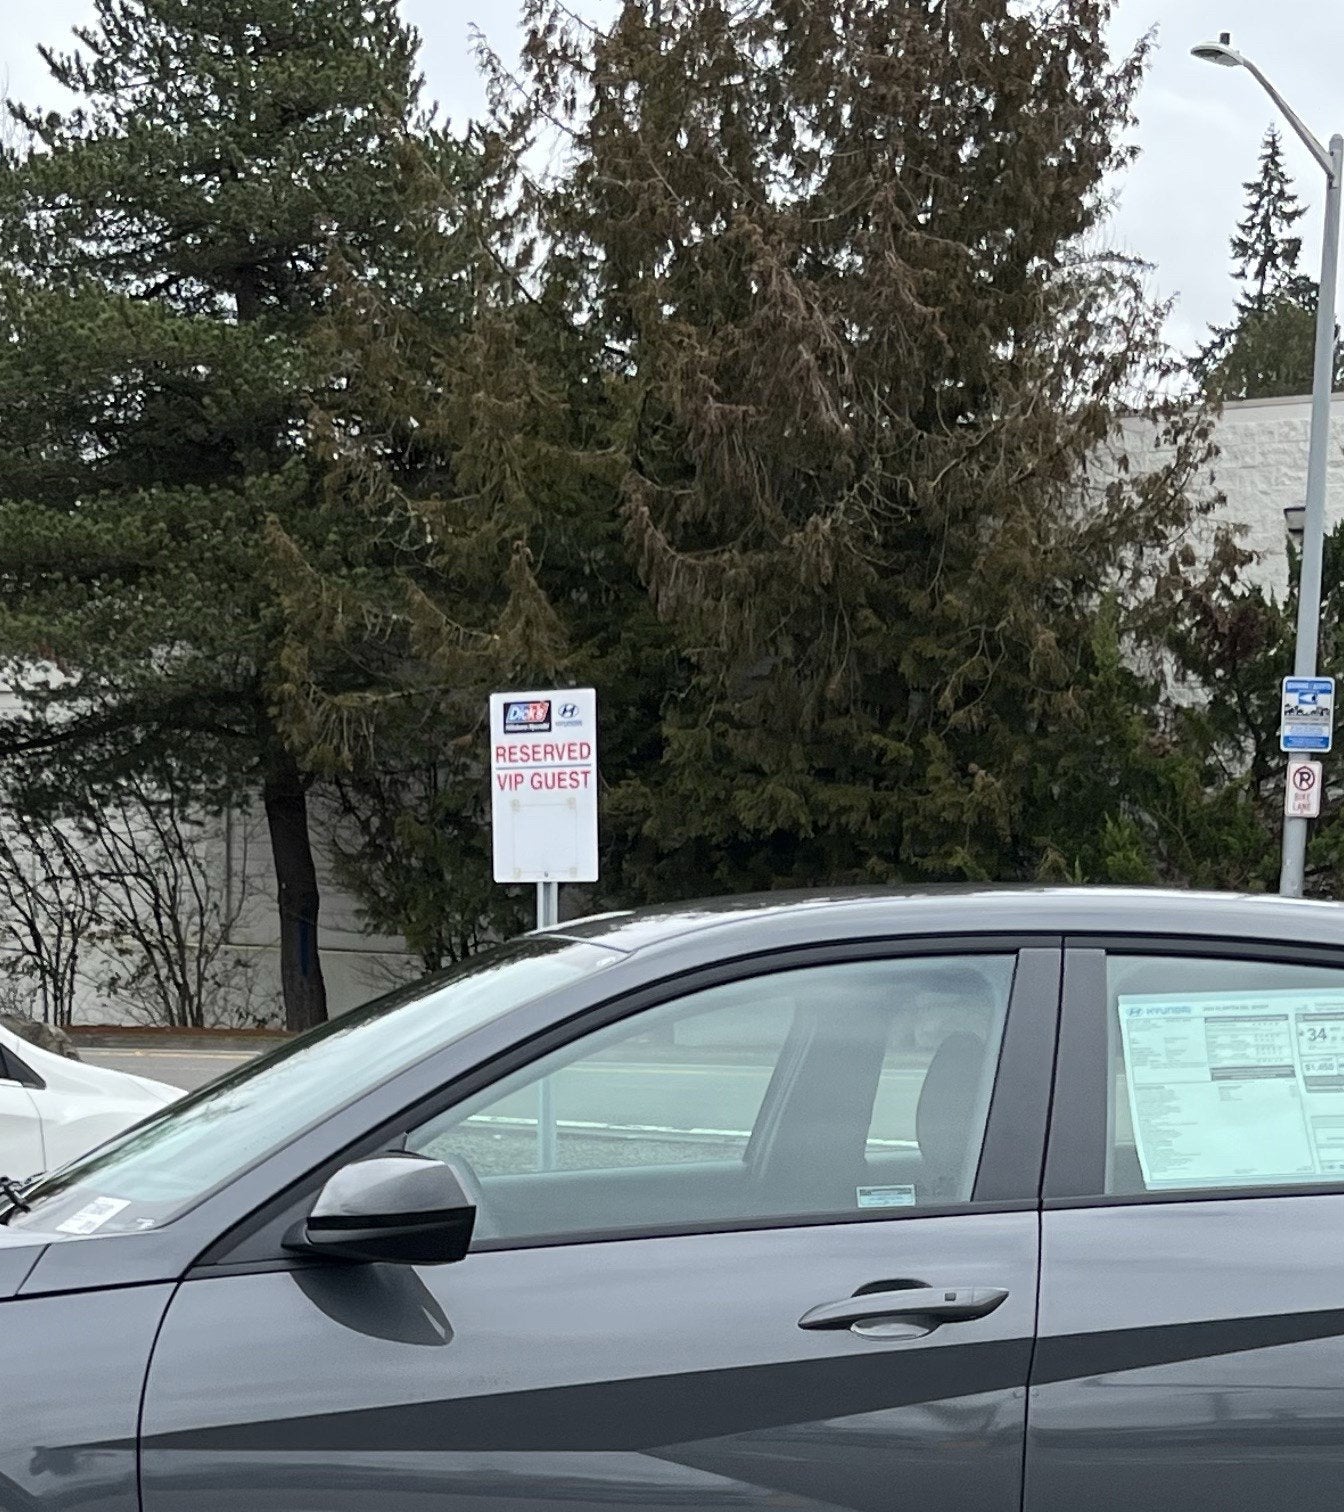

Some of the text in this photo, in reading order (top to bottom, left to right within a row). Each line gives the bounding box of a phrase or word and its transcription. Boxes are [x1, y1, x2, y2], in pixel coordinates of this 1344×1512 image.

[495, 742, 592, 763] RESERVED
[497, 770, 591, 791] VIP GUEST
[1307, 1028, 1328, 1041] 34
